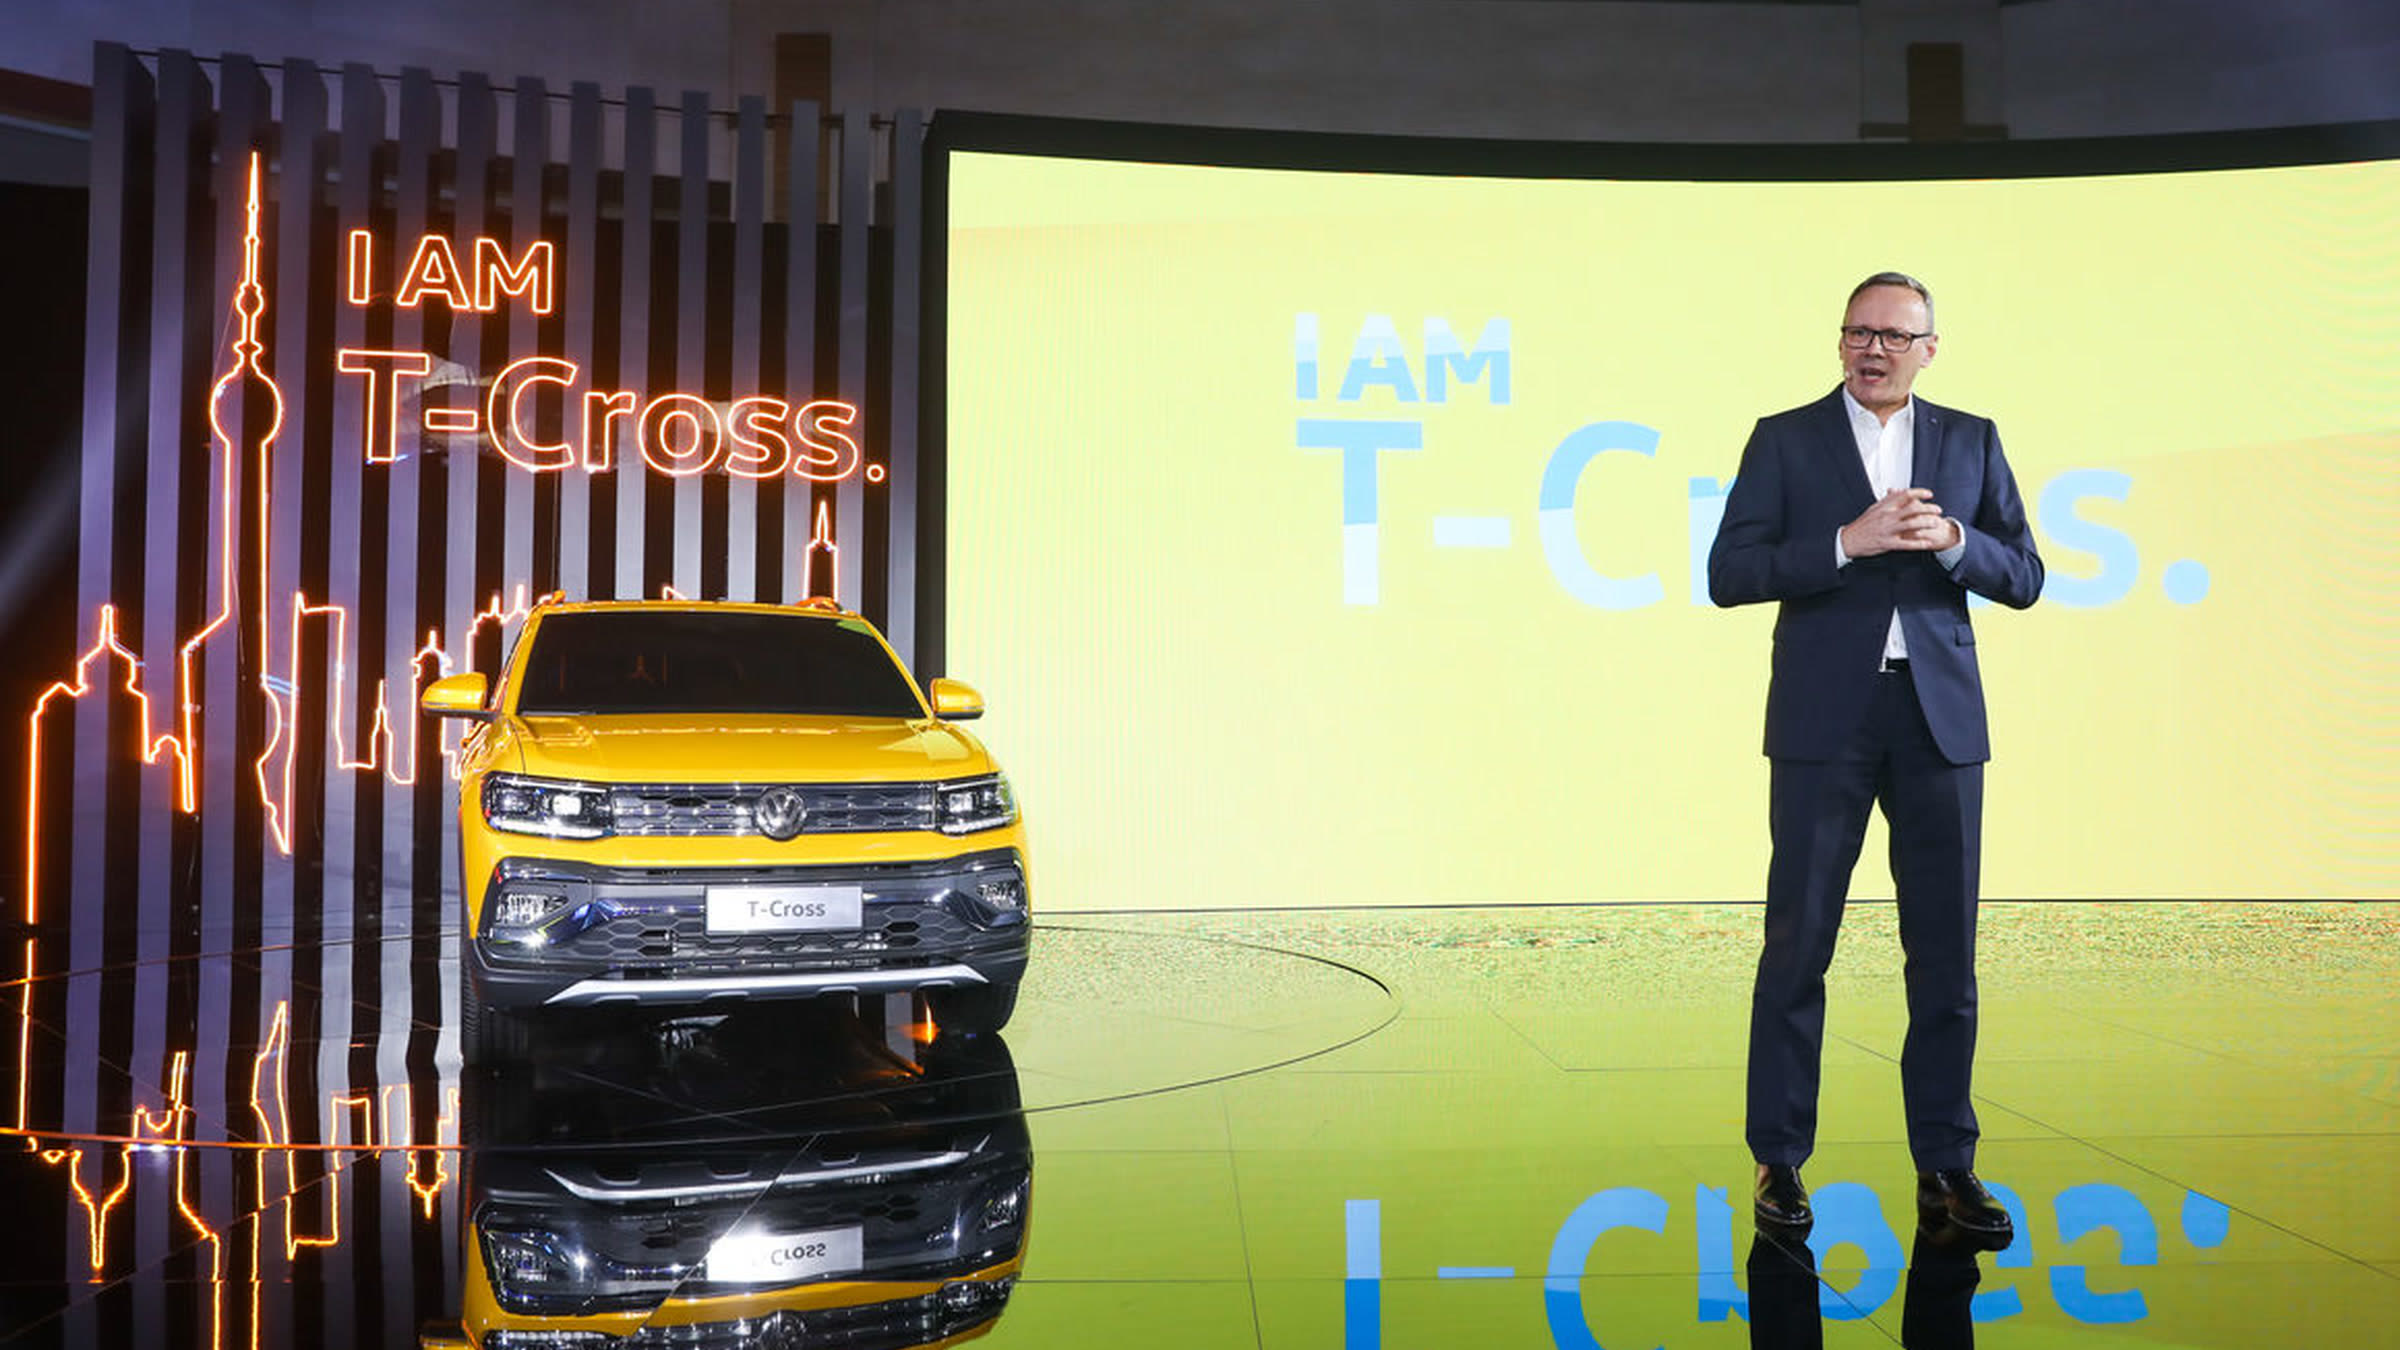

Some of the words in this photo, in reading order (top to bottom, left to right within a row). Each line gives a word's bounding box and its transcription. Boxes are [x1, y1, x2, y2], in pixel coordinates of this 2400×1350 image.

[349, 230, 371, 304] I
[396, 235, 553, 314] AM
[1295, 312, 1319, 400] I
[1337, 314, 1511, 405] AM
[338, 349, 886, 481] T-Cross.
[1296, 418, 2210, 611] T-Crs.
[747, 899, 827, 918] T-Cross
